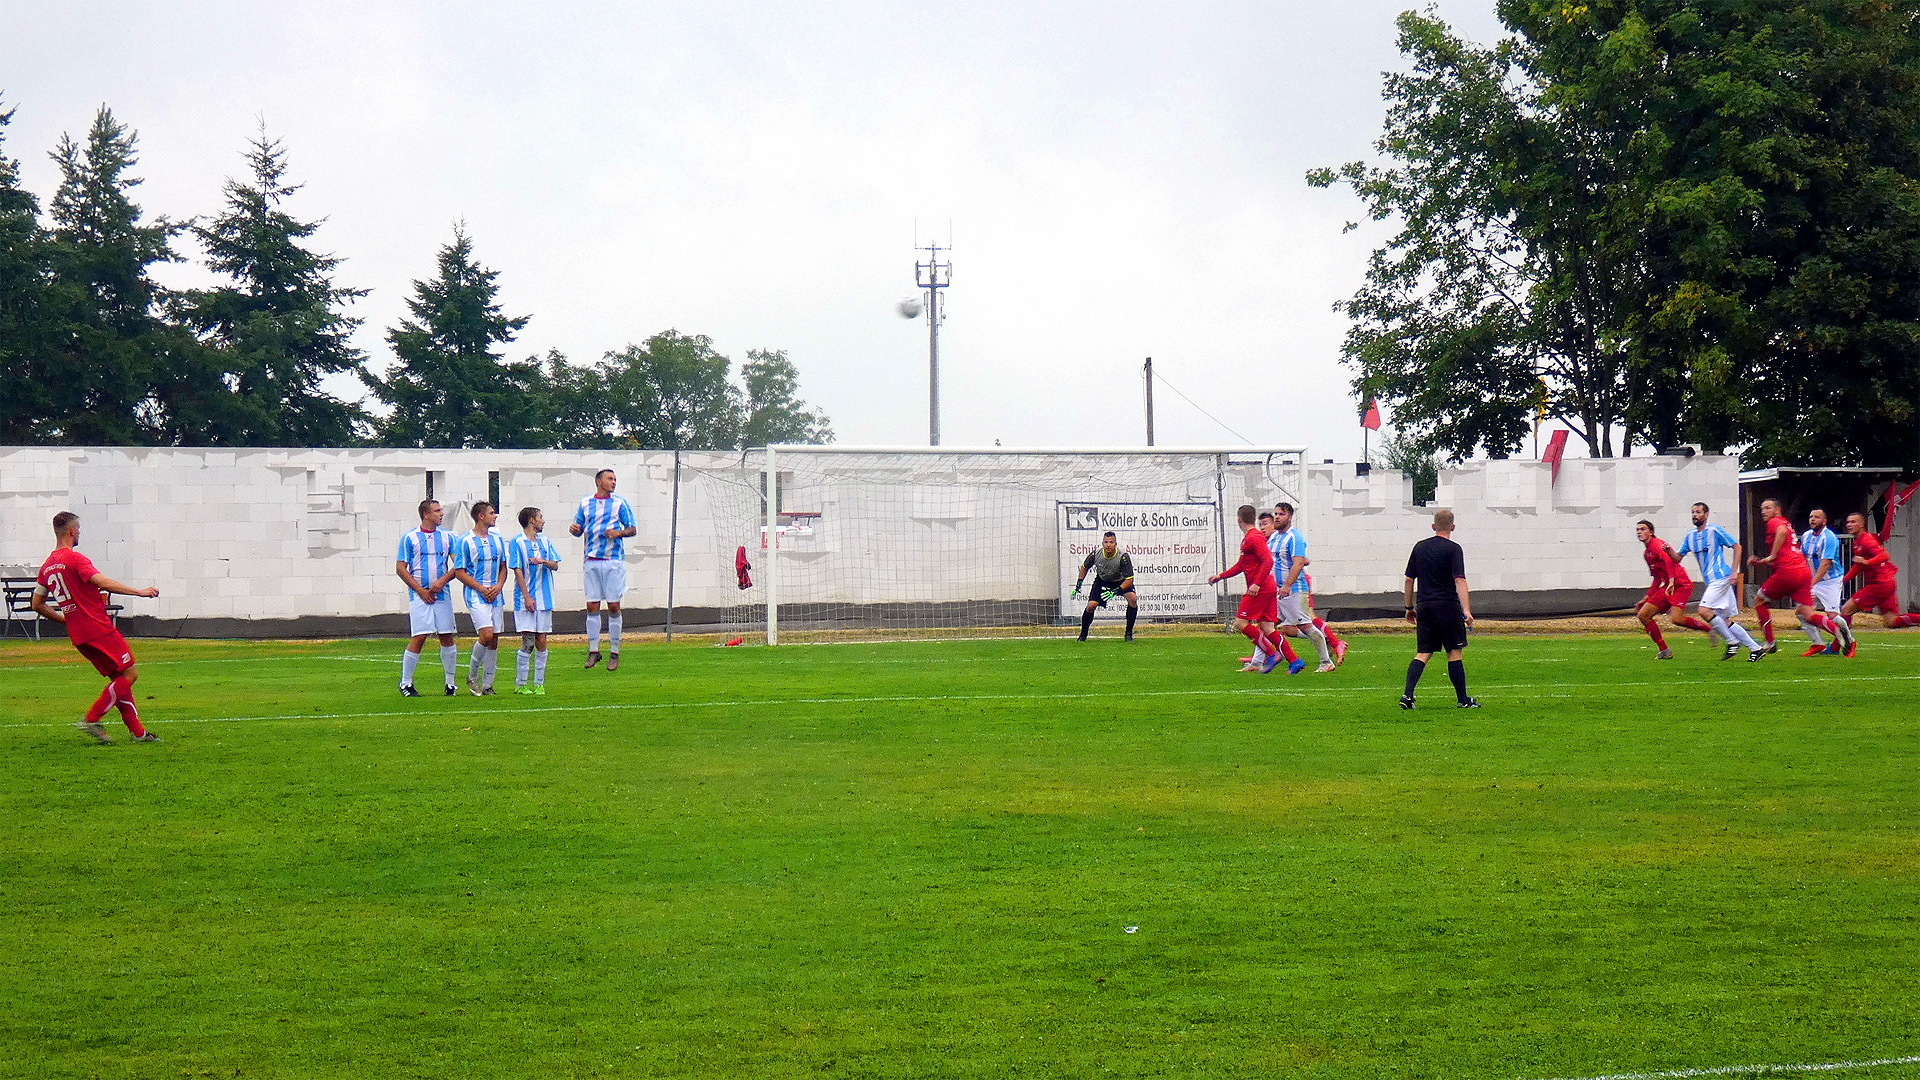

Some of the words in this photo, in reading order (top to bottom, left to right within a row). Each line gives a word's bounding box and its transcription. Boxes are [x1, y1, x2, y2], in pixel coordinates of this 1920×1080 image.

[1101, 512, 1138, 527] Köhler
[1141, 513, 1149, 527] &
[1151, 512, 1179, 527] Sohn
[1182, 516, 1208, 527] GmbH
[1125, 544, 1164, 555] Abbruch
[1173, 543, 1207, 555] Erdbau
[47, 572, 72, 603] 21
[1170, 592, 1202, 601] Friedersdorf
